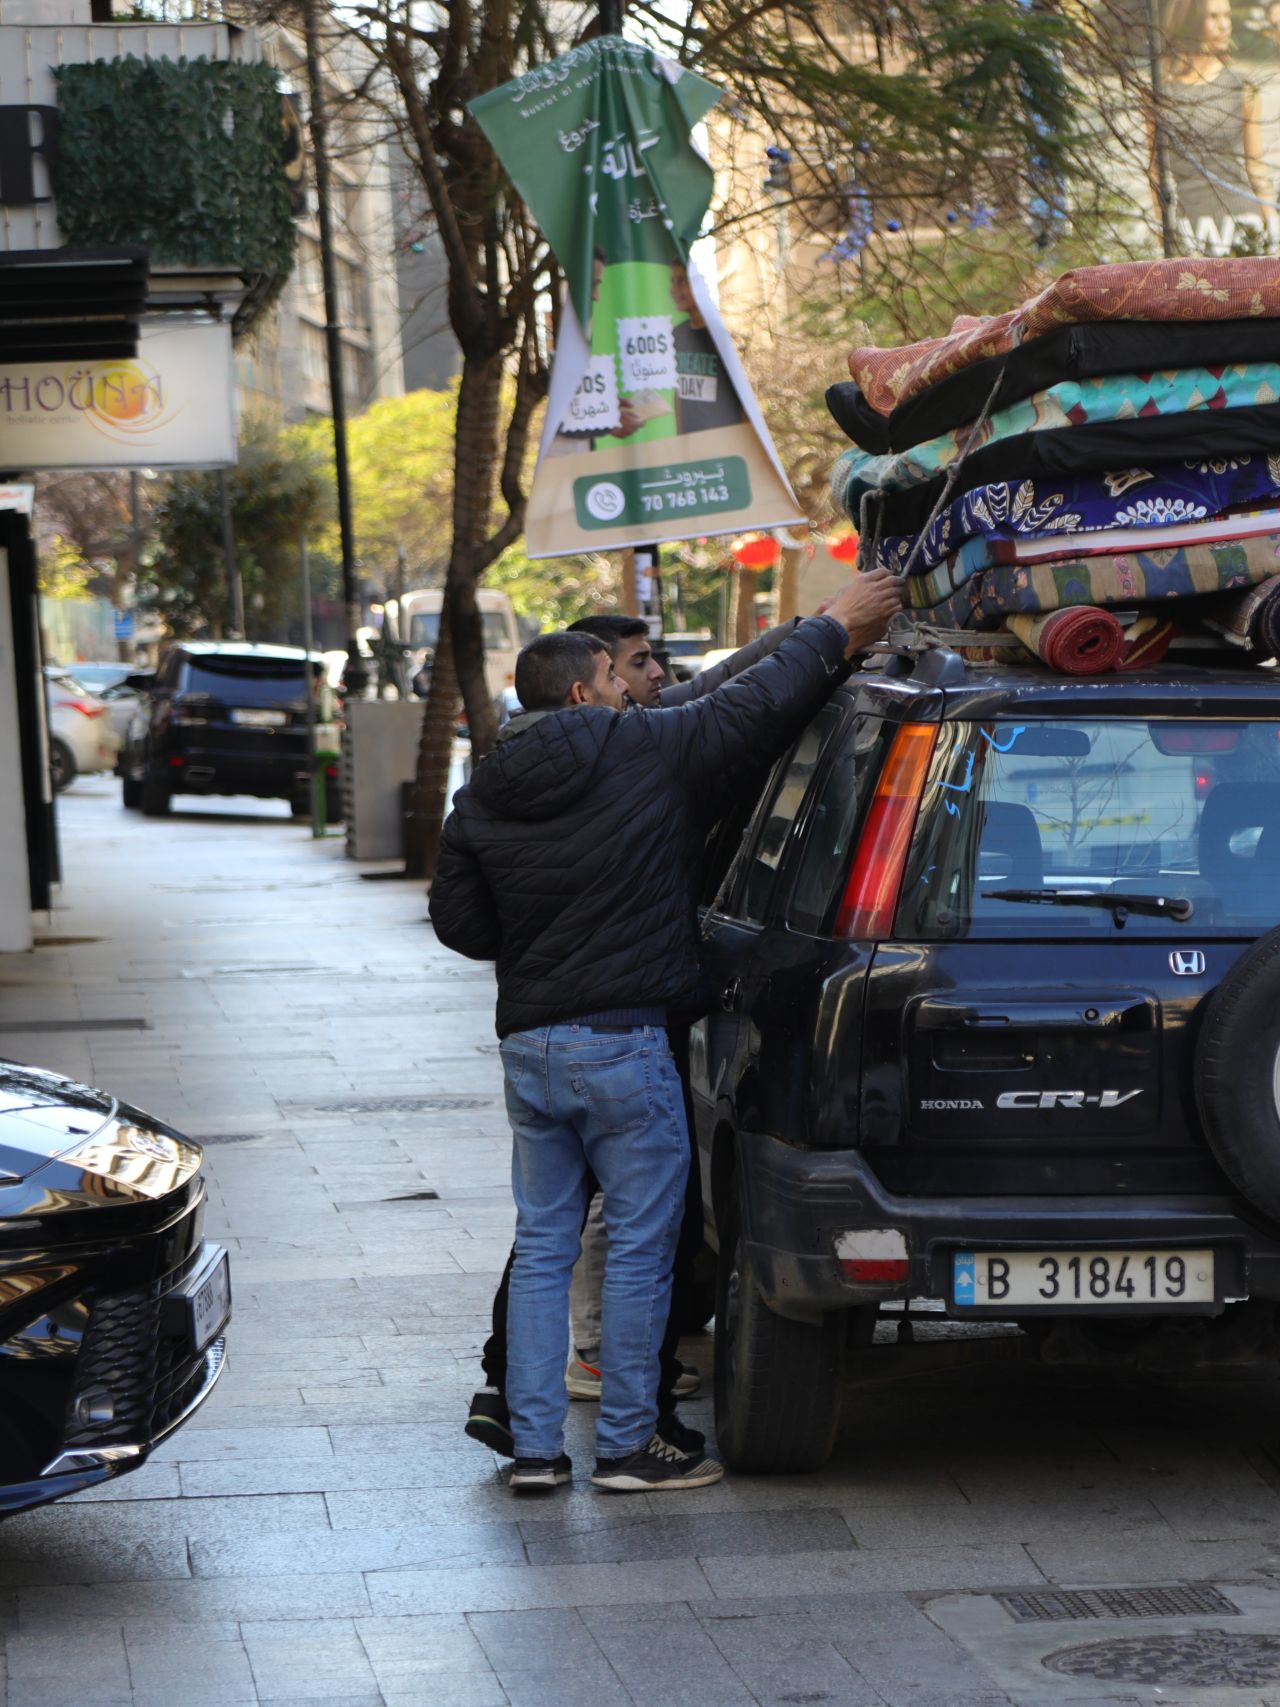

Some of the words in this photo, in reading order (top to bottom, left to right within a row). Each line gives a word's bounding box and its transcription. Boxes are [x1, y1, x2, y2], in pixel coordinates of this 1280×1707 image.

[626, 333, 667, 355] 600$
[641, 495, 664, 512] 70
[668, 489, 698, 509] 768
[702, 486, 729, 503] 143
[920, 1100, 984, 1110] HONDA
[996, 1089, 1144, 1109] CR-V
[988, 1258, 1010, 1299] B
[1038, 1256, 1186, 1298] 318419
